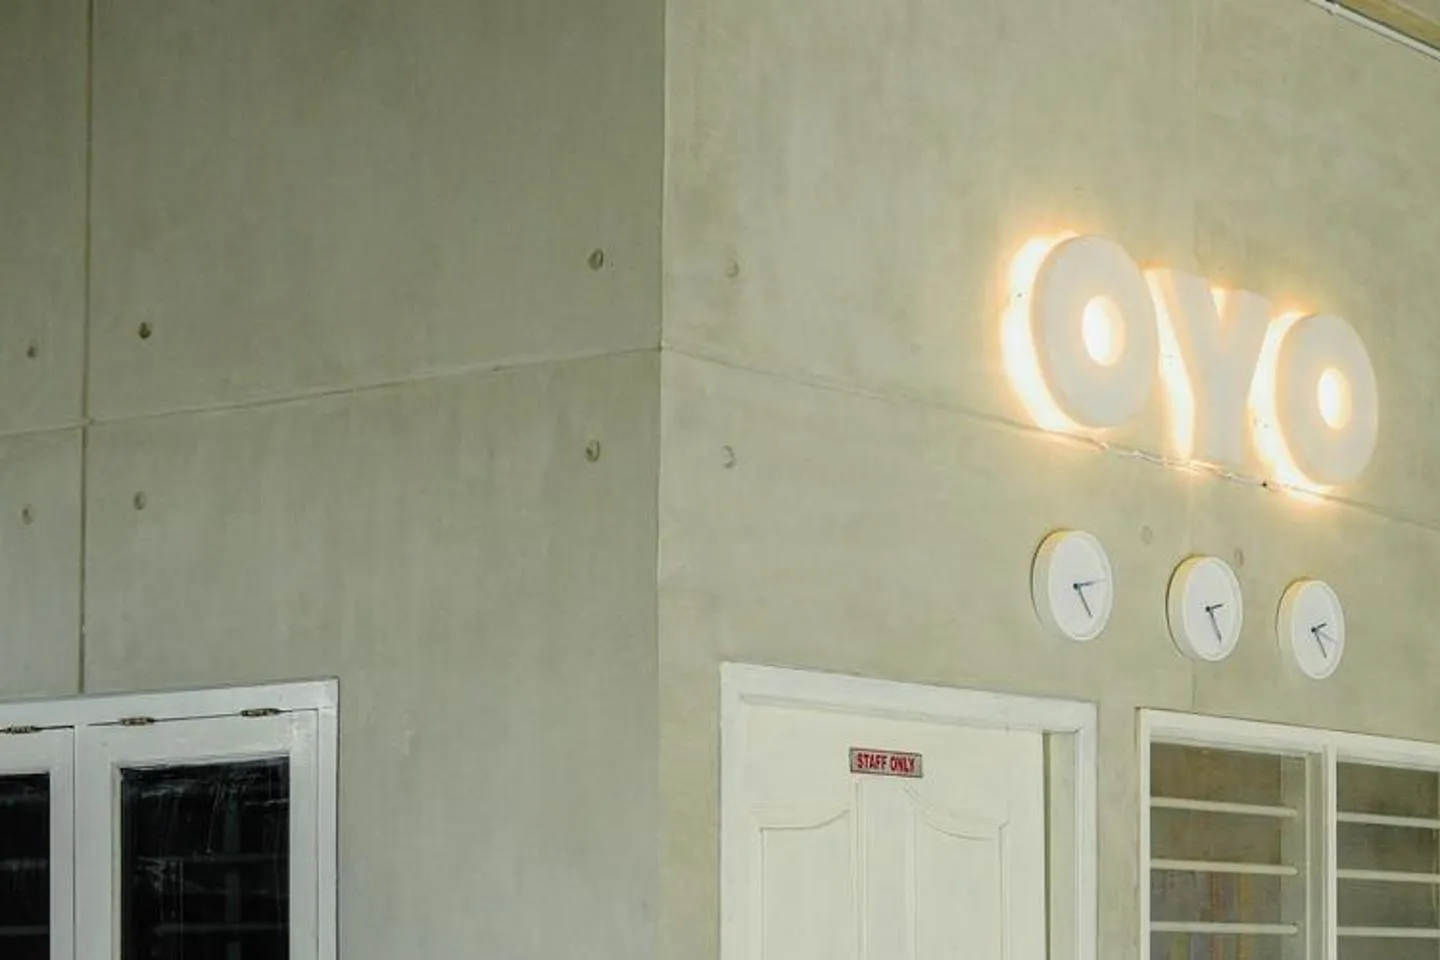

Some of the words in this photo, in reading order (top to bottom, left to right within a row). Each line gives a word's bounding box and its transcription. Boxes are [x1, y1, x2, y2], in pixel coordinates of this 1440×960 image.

[1027, 233, 1379, 487] OYO
[856, 752, 887, 770] STAFF
[890, 755, 916, 773] ONLY
